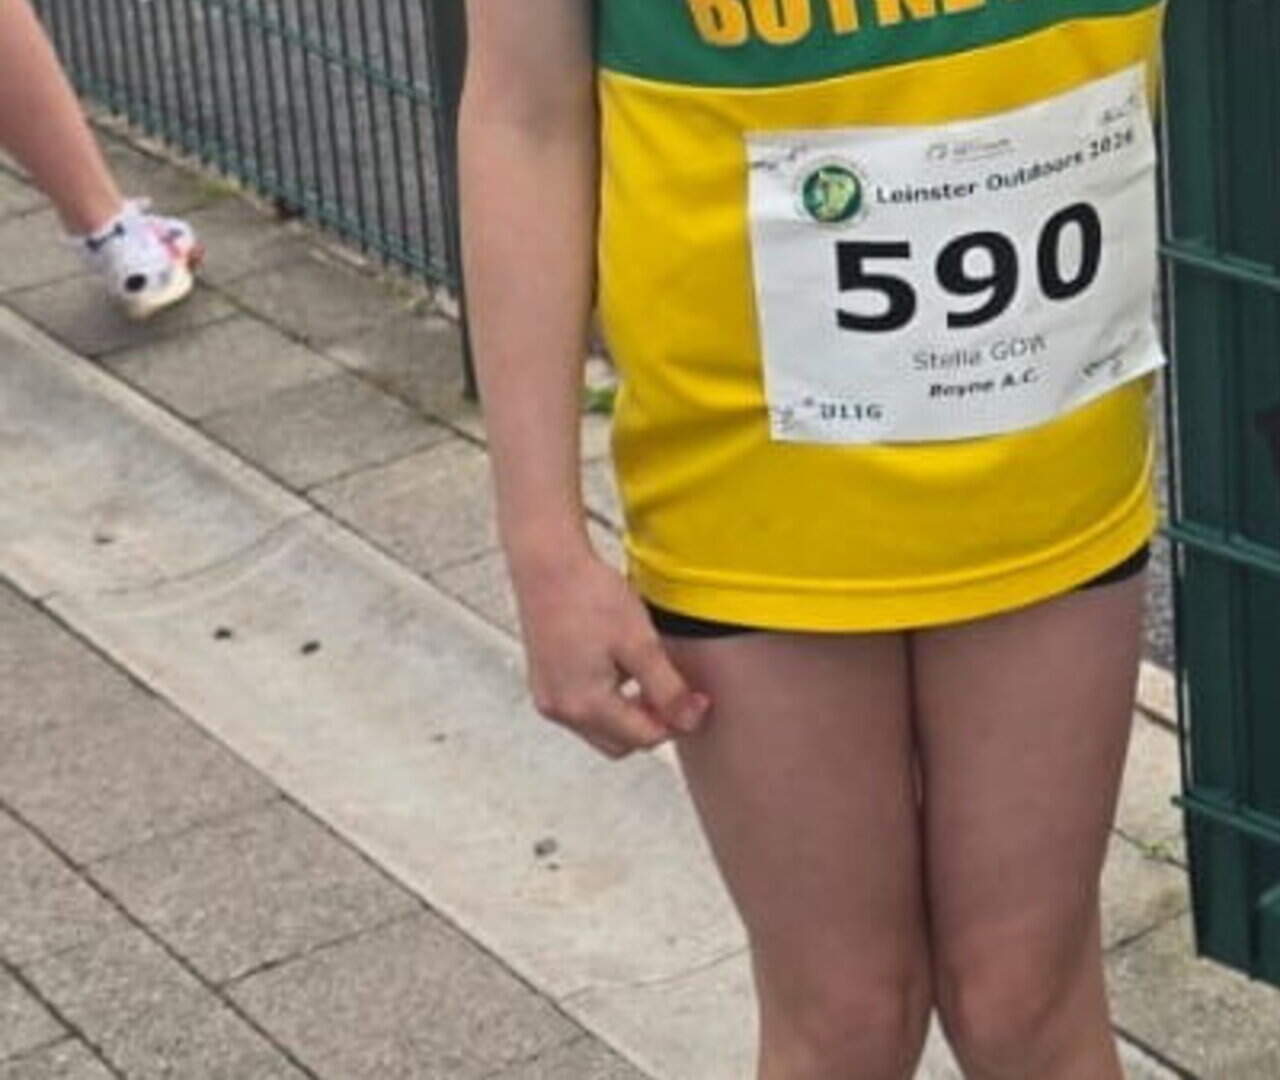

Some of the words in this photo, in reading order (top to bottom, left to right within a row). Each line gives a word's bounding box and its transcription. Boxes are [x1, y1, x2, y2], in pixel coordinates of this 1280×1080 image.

[876, 182, 978, 205] Leinster
[985, 151, 1084, 191] Outdoors
[1089, 128, 1135, 161] 2026
[833, 201, 1102, 333] 590
[912, 349, 982, 372] Stella
[928, 379, 995, 398] Boyne
